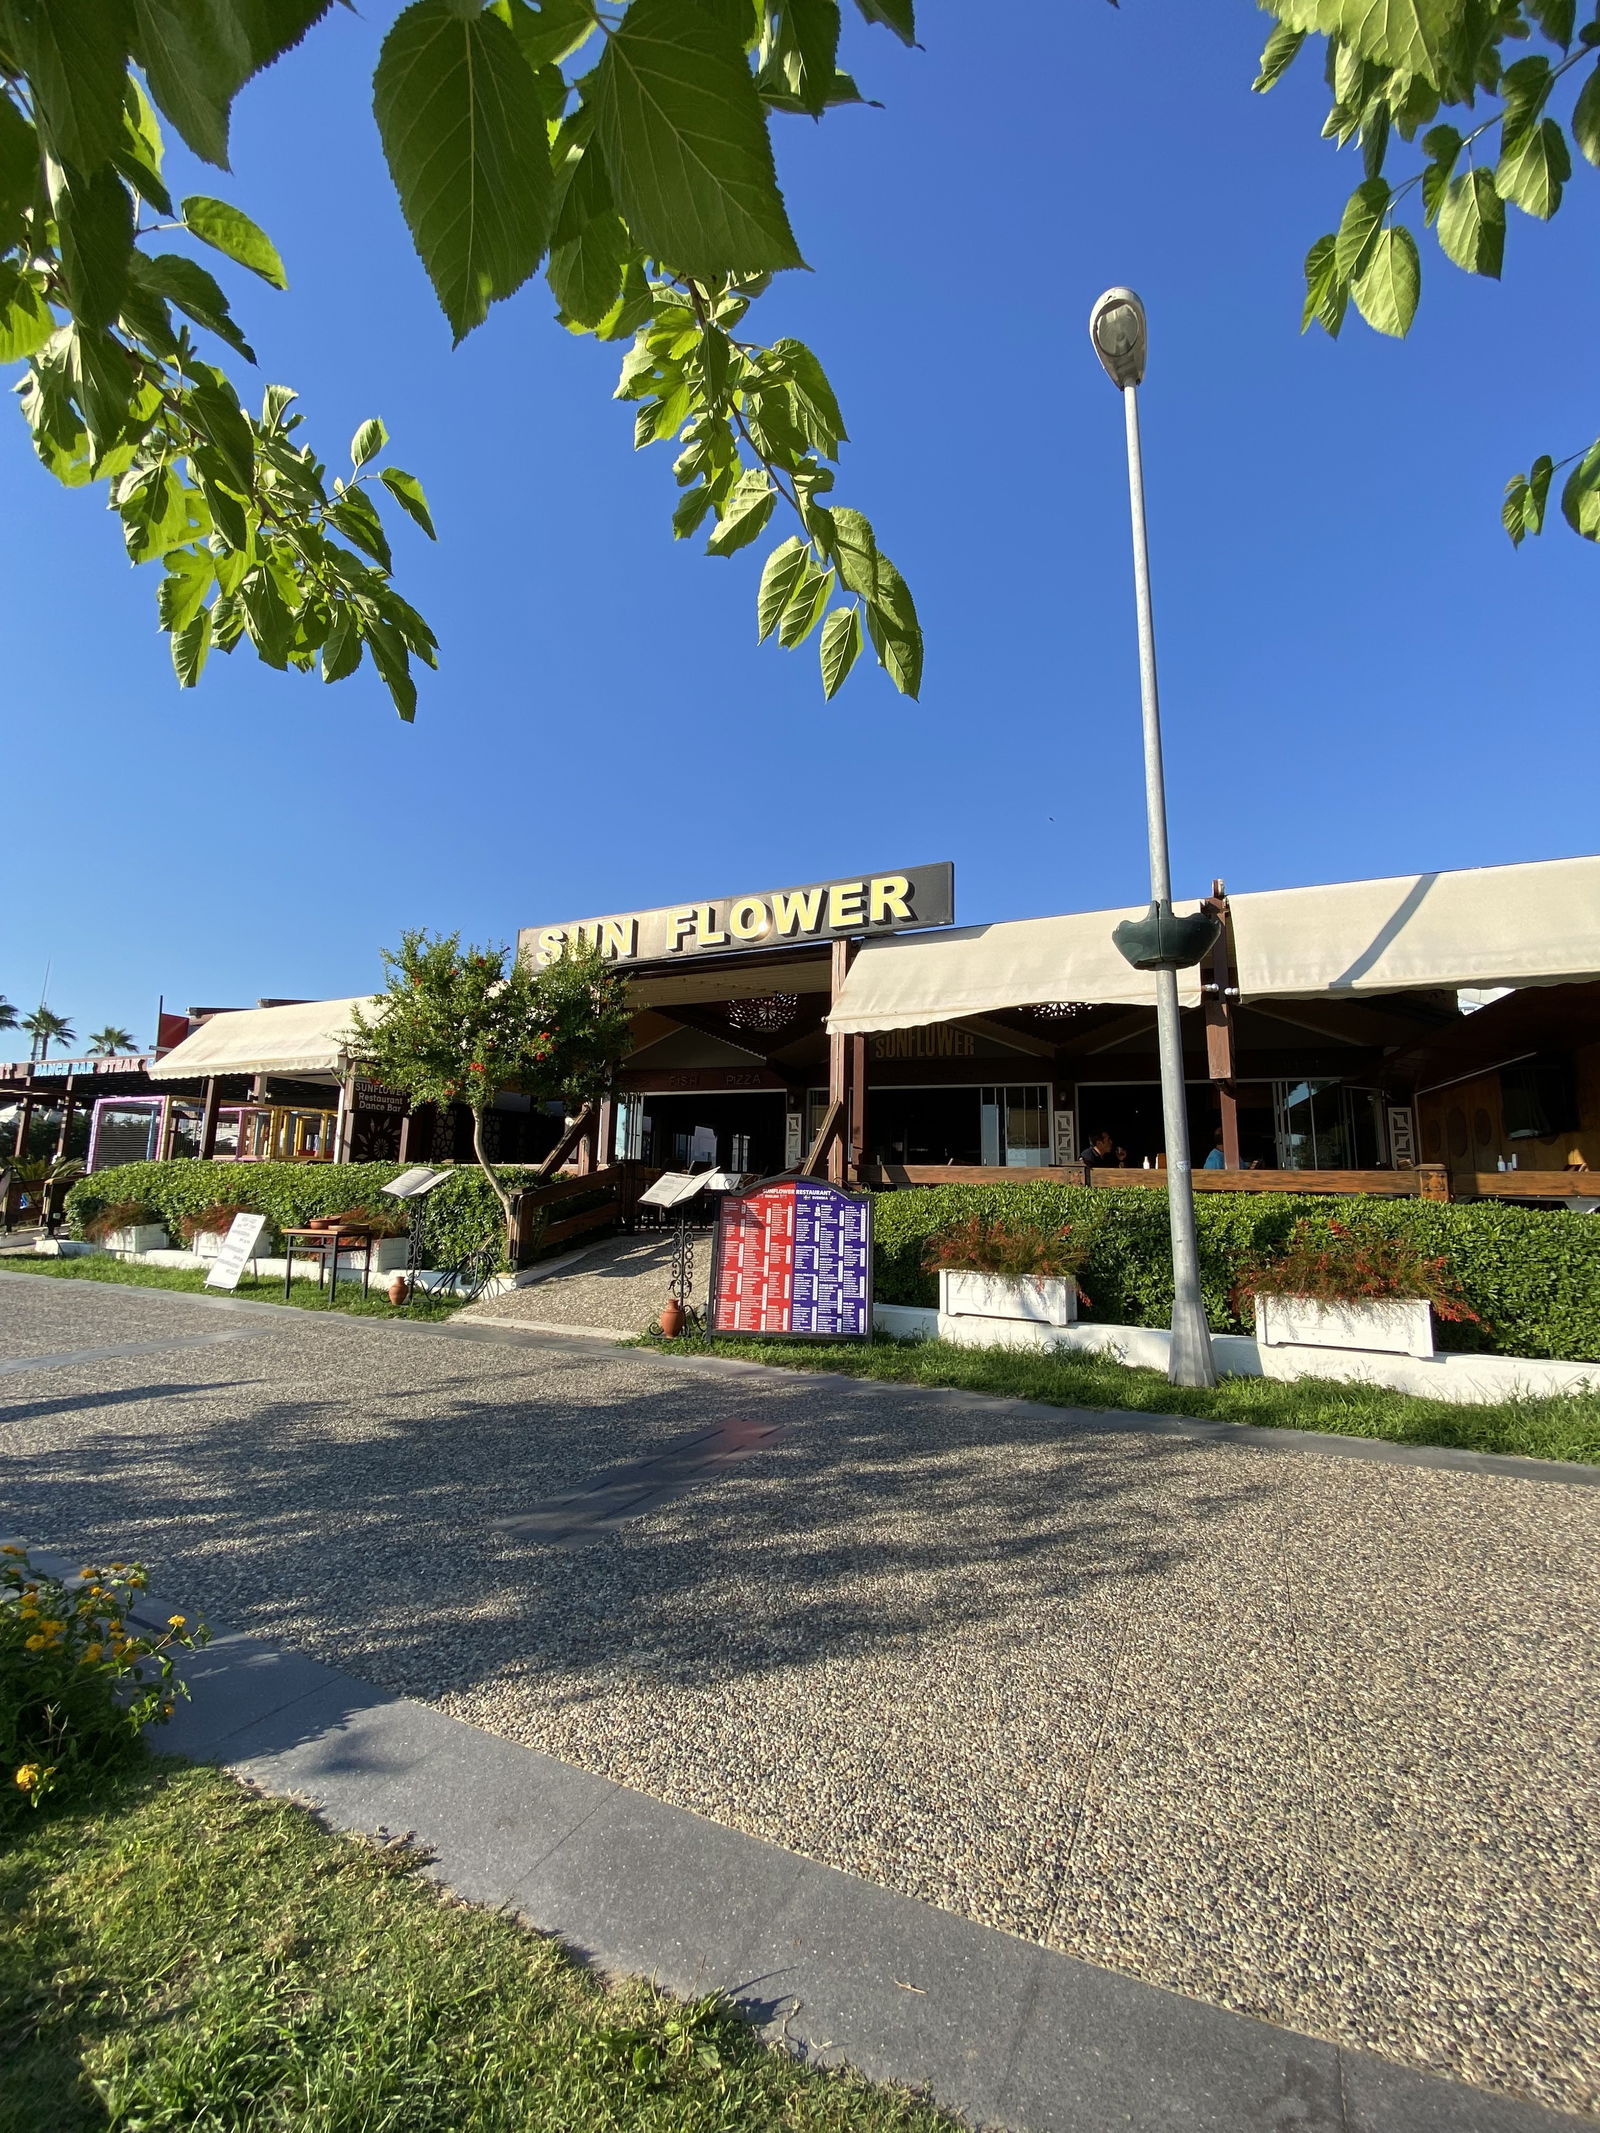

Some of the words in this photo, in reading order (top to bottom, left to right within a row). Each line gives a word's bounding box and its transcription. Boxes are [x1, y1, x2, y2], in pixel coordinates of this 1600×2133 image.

[536, 917, 636, 966] SUN
[665, 876, 913, 945] FLOWER
[34, 1062, 69, 1077] DANCE
[71, 1062, 94, 1075] BAR
[100, 1059, 140, 1073] STEAK
[359, 1092, 403, 1105] Restaurant
[359, 1101, 385, 1110] Dance
[387, 1103, 402, 1112] Bar
